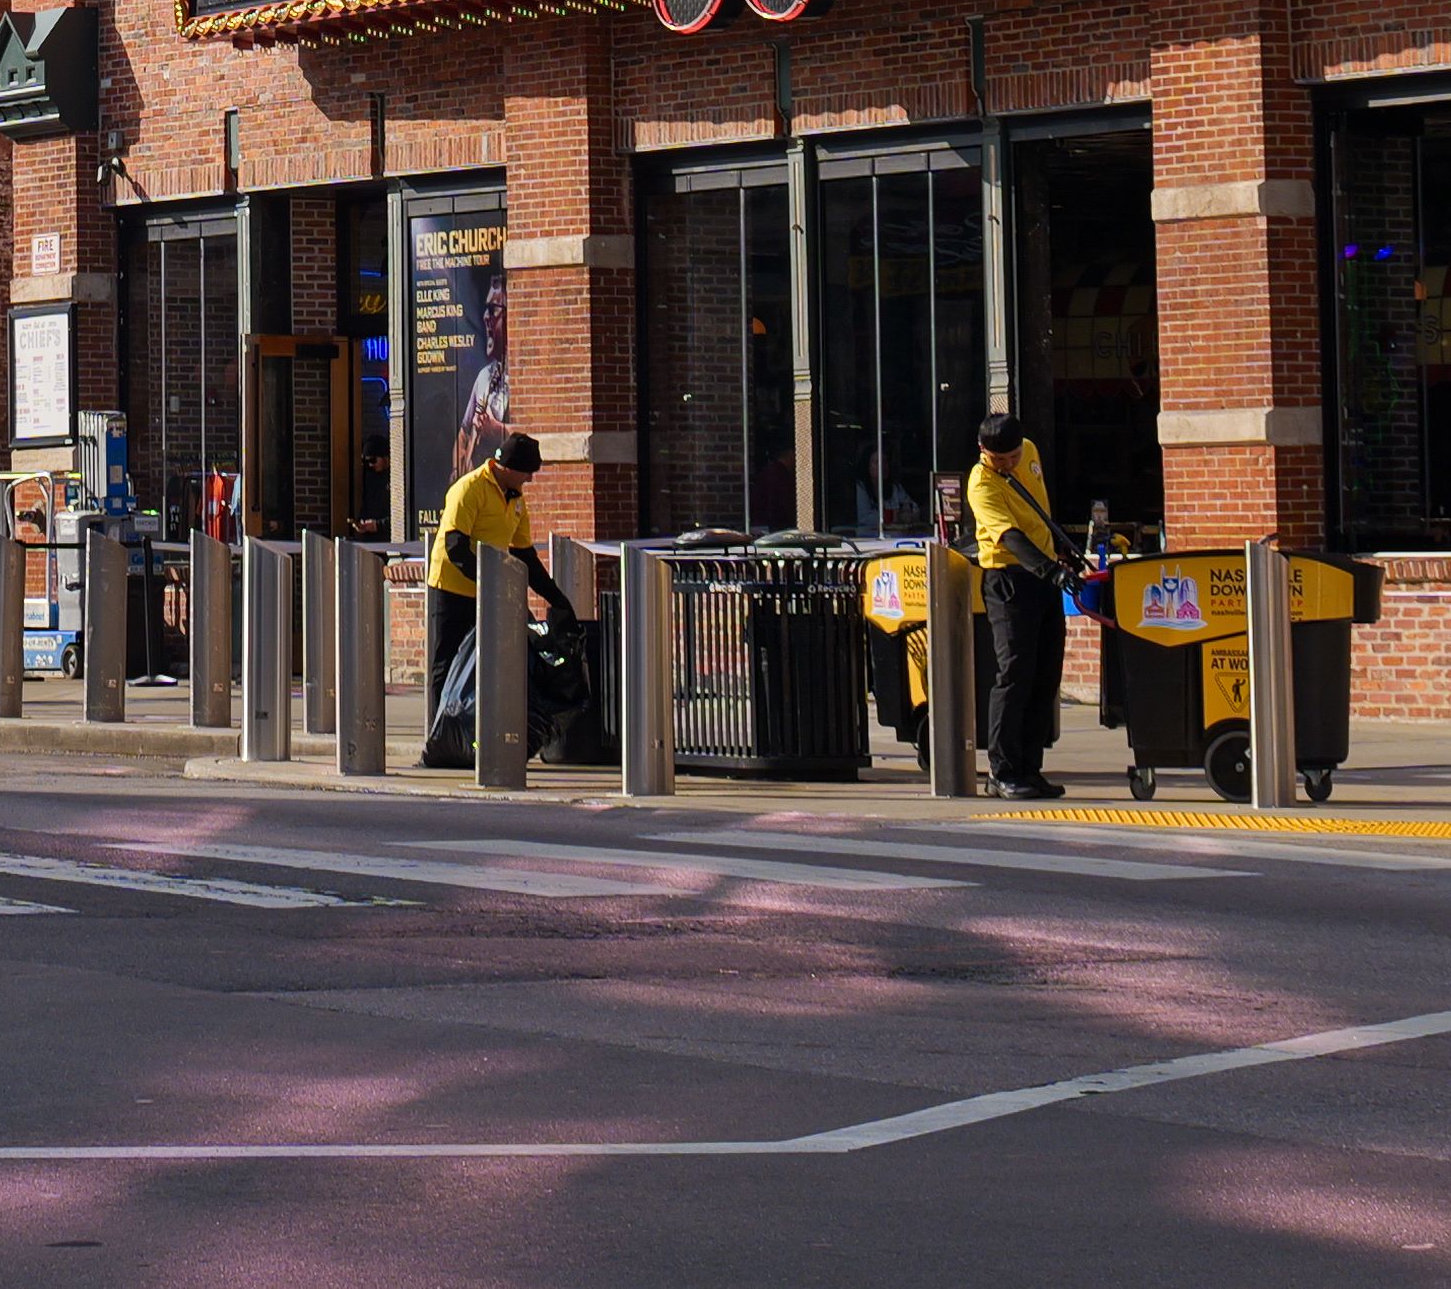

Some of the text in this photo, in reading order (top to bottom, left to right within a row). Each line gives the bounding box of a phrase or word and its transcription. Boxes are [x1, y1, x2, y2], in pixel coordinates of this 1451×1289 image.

[37, 239, 54, 252] FIRE
[416, 226, 507, 257] ERIC CHURCH
[473, 254, 490, 266] TOUR
[418, 509, 439, 525] FALL
[1211, 657, 1225, 669] AT
